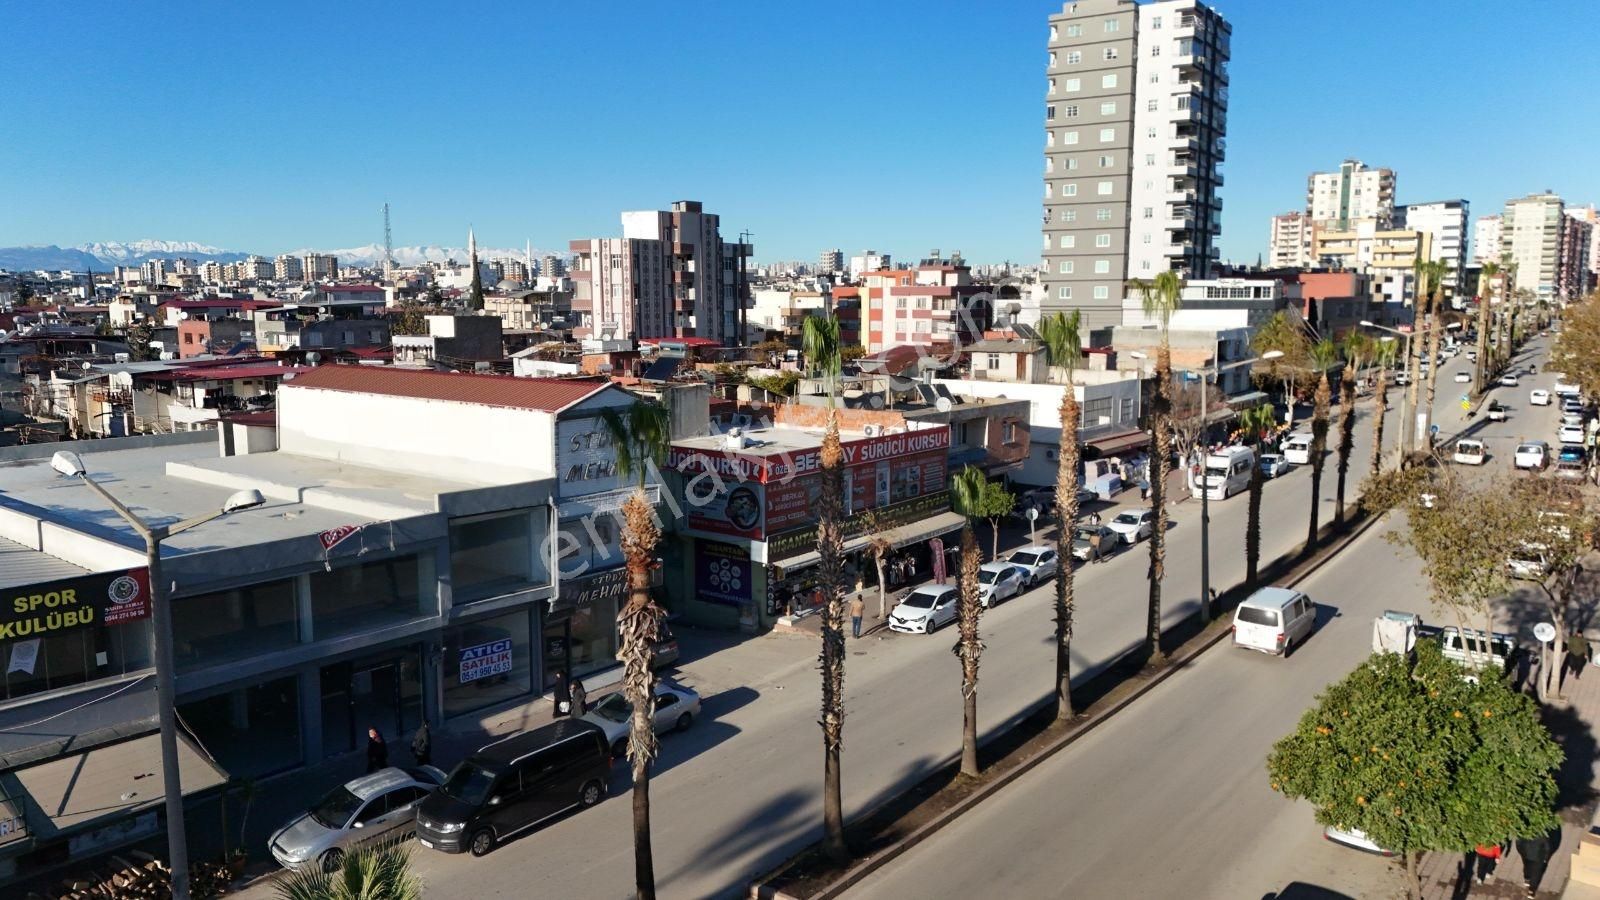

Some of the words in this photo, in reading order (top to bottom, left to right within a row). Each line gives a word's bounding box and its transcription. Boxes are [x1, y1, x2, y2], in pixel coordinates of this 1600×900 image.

[861, 436, 906, 461] SÜRÜCÜ
[907, 433, 942, 452] KURSU
[13, 588, 77, 613] SPOR
[0, 605, 94, 639] KULÜBÜ
[462, 640, 510, 660] ATICI
[462, 652, 510, 672] SATILIK
[479, 665, 492, 678] 950
